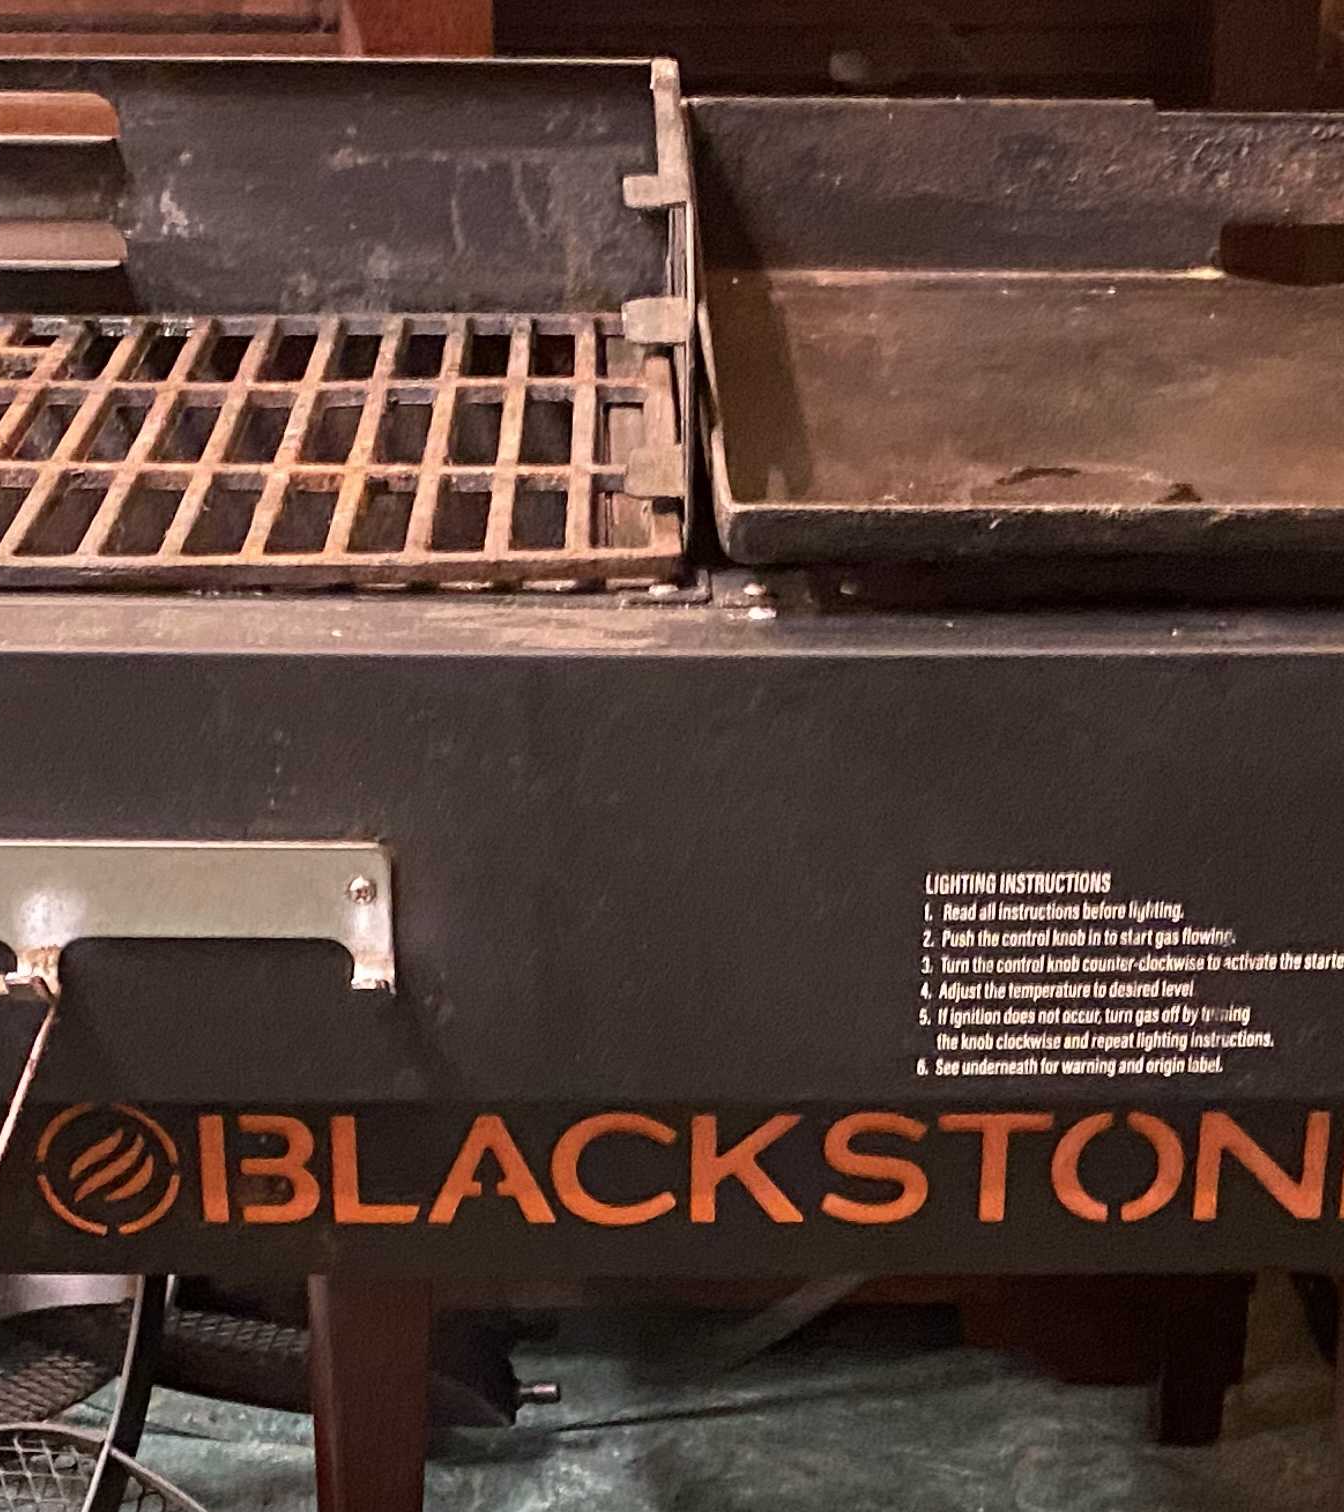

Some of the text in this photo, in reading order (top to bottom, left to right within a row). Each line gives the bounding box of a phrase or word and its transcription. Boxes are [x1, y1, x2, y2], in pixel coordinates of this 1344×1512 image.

[925, 872, 1112, 894] LIGHTING INSTRUCTIONS
[943, 902, 977, 921] Read
[978, 902, 996, 921] all
[998, 902, 1080, 920] instructions
[1082, 902, 1126, 920] before
[942, 929, 975, 947] Push
[977, 929, 1000, 947] the
[1001, 929, 1050, 947] control
[1052, 929, 1086, 947] knob
[1088, 929, 1101, 947] in
[1104, 929, 1118, 947] to
[1120, 927, 1152, 947] start
[1155, 929, 1179, 949] gas
[941, 955, 970, 973] Turn
[972, 955, 994, 973] the
[996, 955, 1045, 973] control
[1046, 955, 1080, 973] knob
[1082, 952, 1205, 973] counter-clockwise
[1206, 953, 1221, 971] to
[1222, 951, 1278, 971] activate
[1279, 951, 1302, 970] the
[939, 982, 981, 1003] Adjust
[984, 982, 1006, 1000] the
[1008, 982, 1091, 1002] temperature
[1093, 980, 1107, 998] to
[1108, 979, 1159, 998] desired
[1003, 1007, 1036, 1025] does
[1038, 1007, 1060, 1025] not
[1104, 1007, 1133, 1023] turn
[1135, 1007, 1160, 1026] gas
[1161, 1005, 1181, 1024] off
[1182, 1005, 1200, 1026] by
[936, 1033, 958, 1050] the
[960, 1033, 993, 1050] knob
[996, 1033, 1061, 1050] clockwise
[1063, 1033, 1089, 1050] and
[1090, 1033, 1134, 1051] repeat
[1136, 1033, 1188, 1051] lighting
[935, 1058, 960, 1075] See
[961, 1058, 1038, 1075] underneath
[1040, 1058, 1060, 1075] for
[1061, 1057, 1117, 1077] warning
[1118, 1056, 1145, 1074] and
[1145, 1056, 1186, 1077] origin
